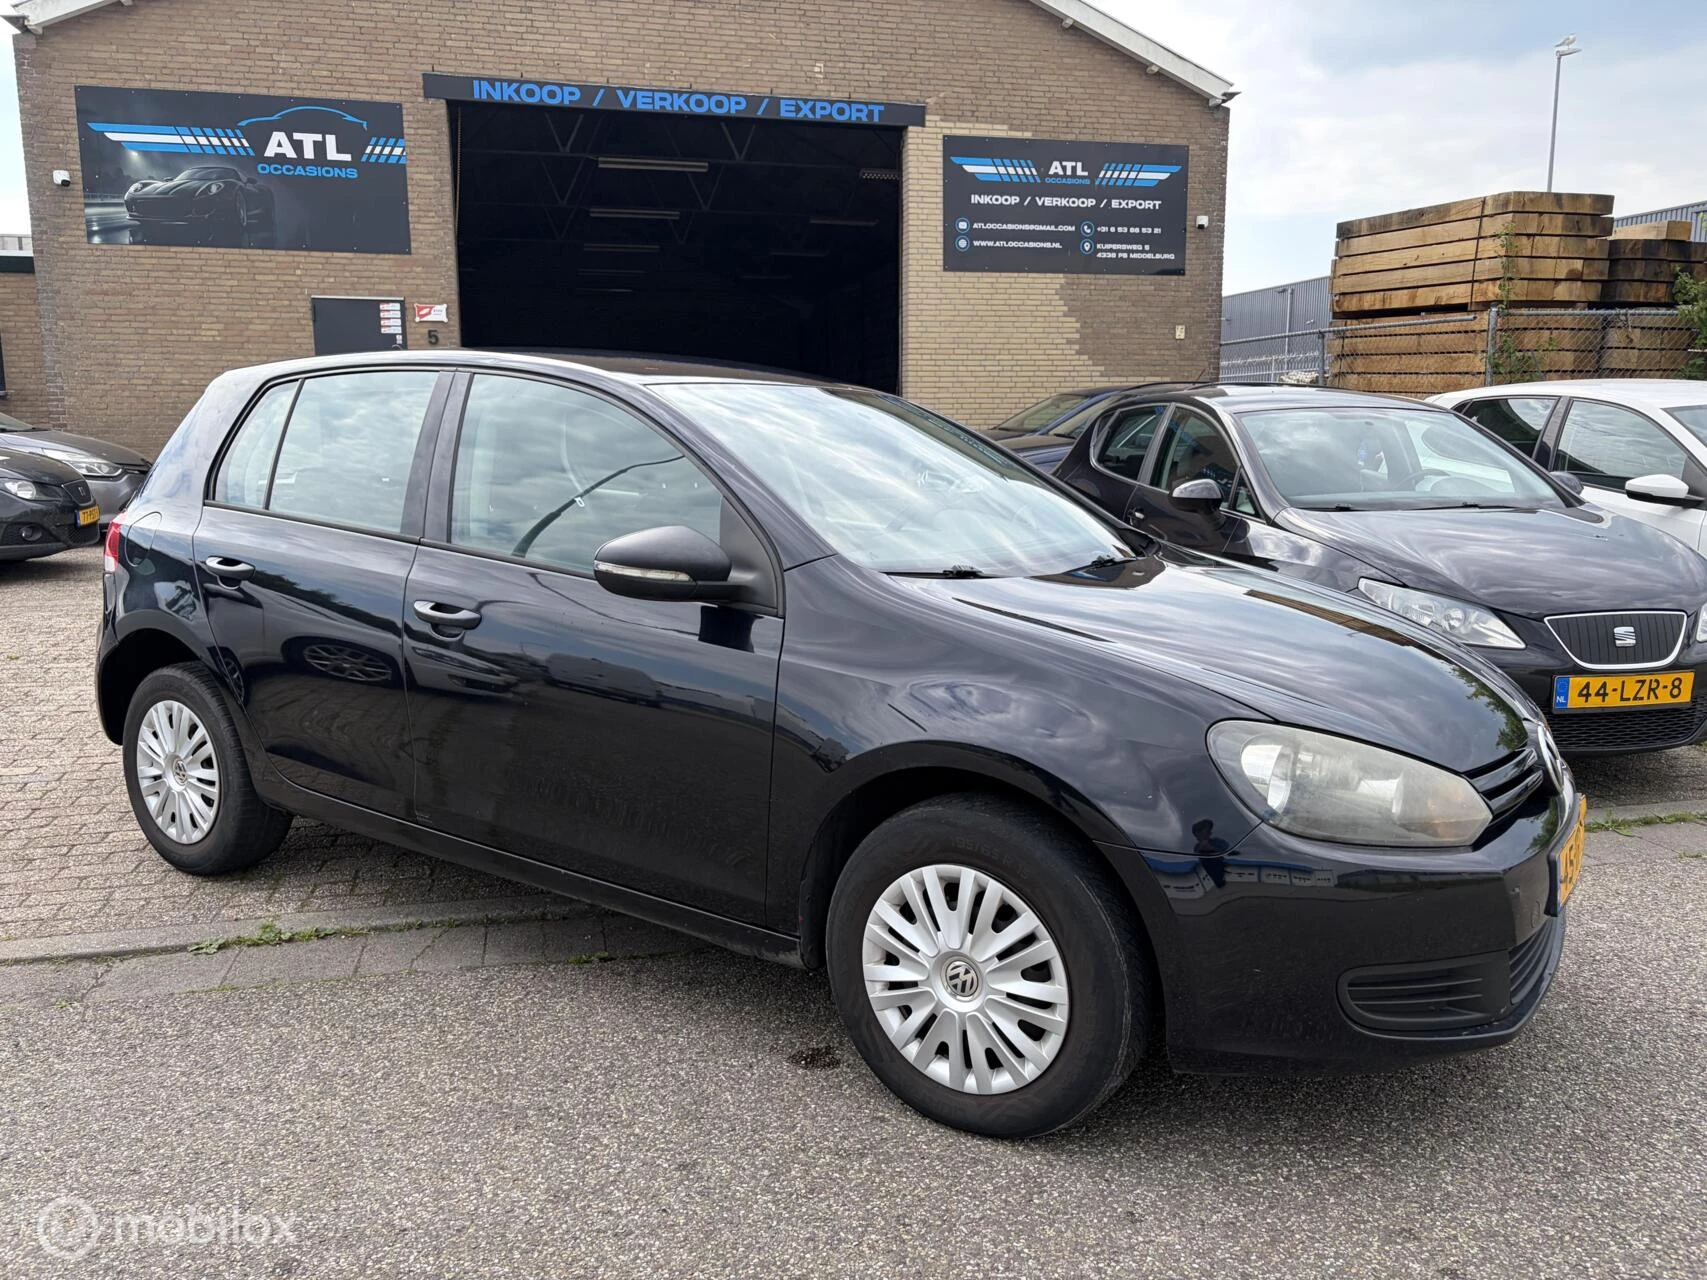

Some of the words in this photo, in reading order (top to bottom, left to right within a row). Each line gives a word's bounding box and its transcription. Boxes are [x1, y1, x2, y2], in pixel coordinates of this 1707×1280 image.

[472, 79, 581, 105] INKOOP
[592, 89, 606, 107] /
[616, 89, 748, 115] VERKOOP
[756, 98, 770, 116] /
[779, 100, 885, 122] EXPORT
[263, 131, 352, 161] ATL
[256, 162, 358, 179] OCCASIONS
[1048, 161, 1088, 176] ATL
[1045, 177, 1090, 185] OCCASIONS
[971, 194, 1020, 205] INKOOP
[1024, 197, 1031, 205] /
[1035, 197, 1096, 207] VERKOOP
[1100, 199, 1107, 208] /
[1111, 199, 1162, 209] EXPORT
[973, 240, 1062, 248] WWW.ATLOCCASIONS.NL
[427, 329, 440, 345] 5
[1577, 677, 1683, 703] 44-LZR-8
